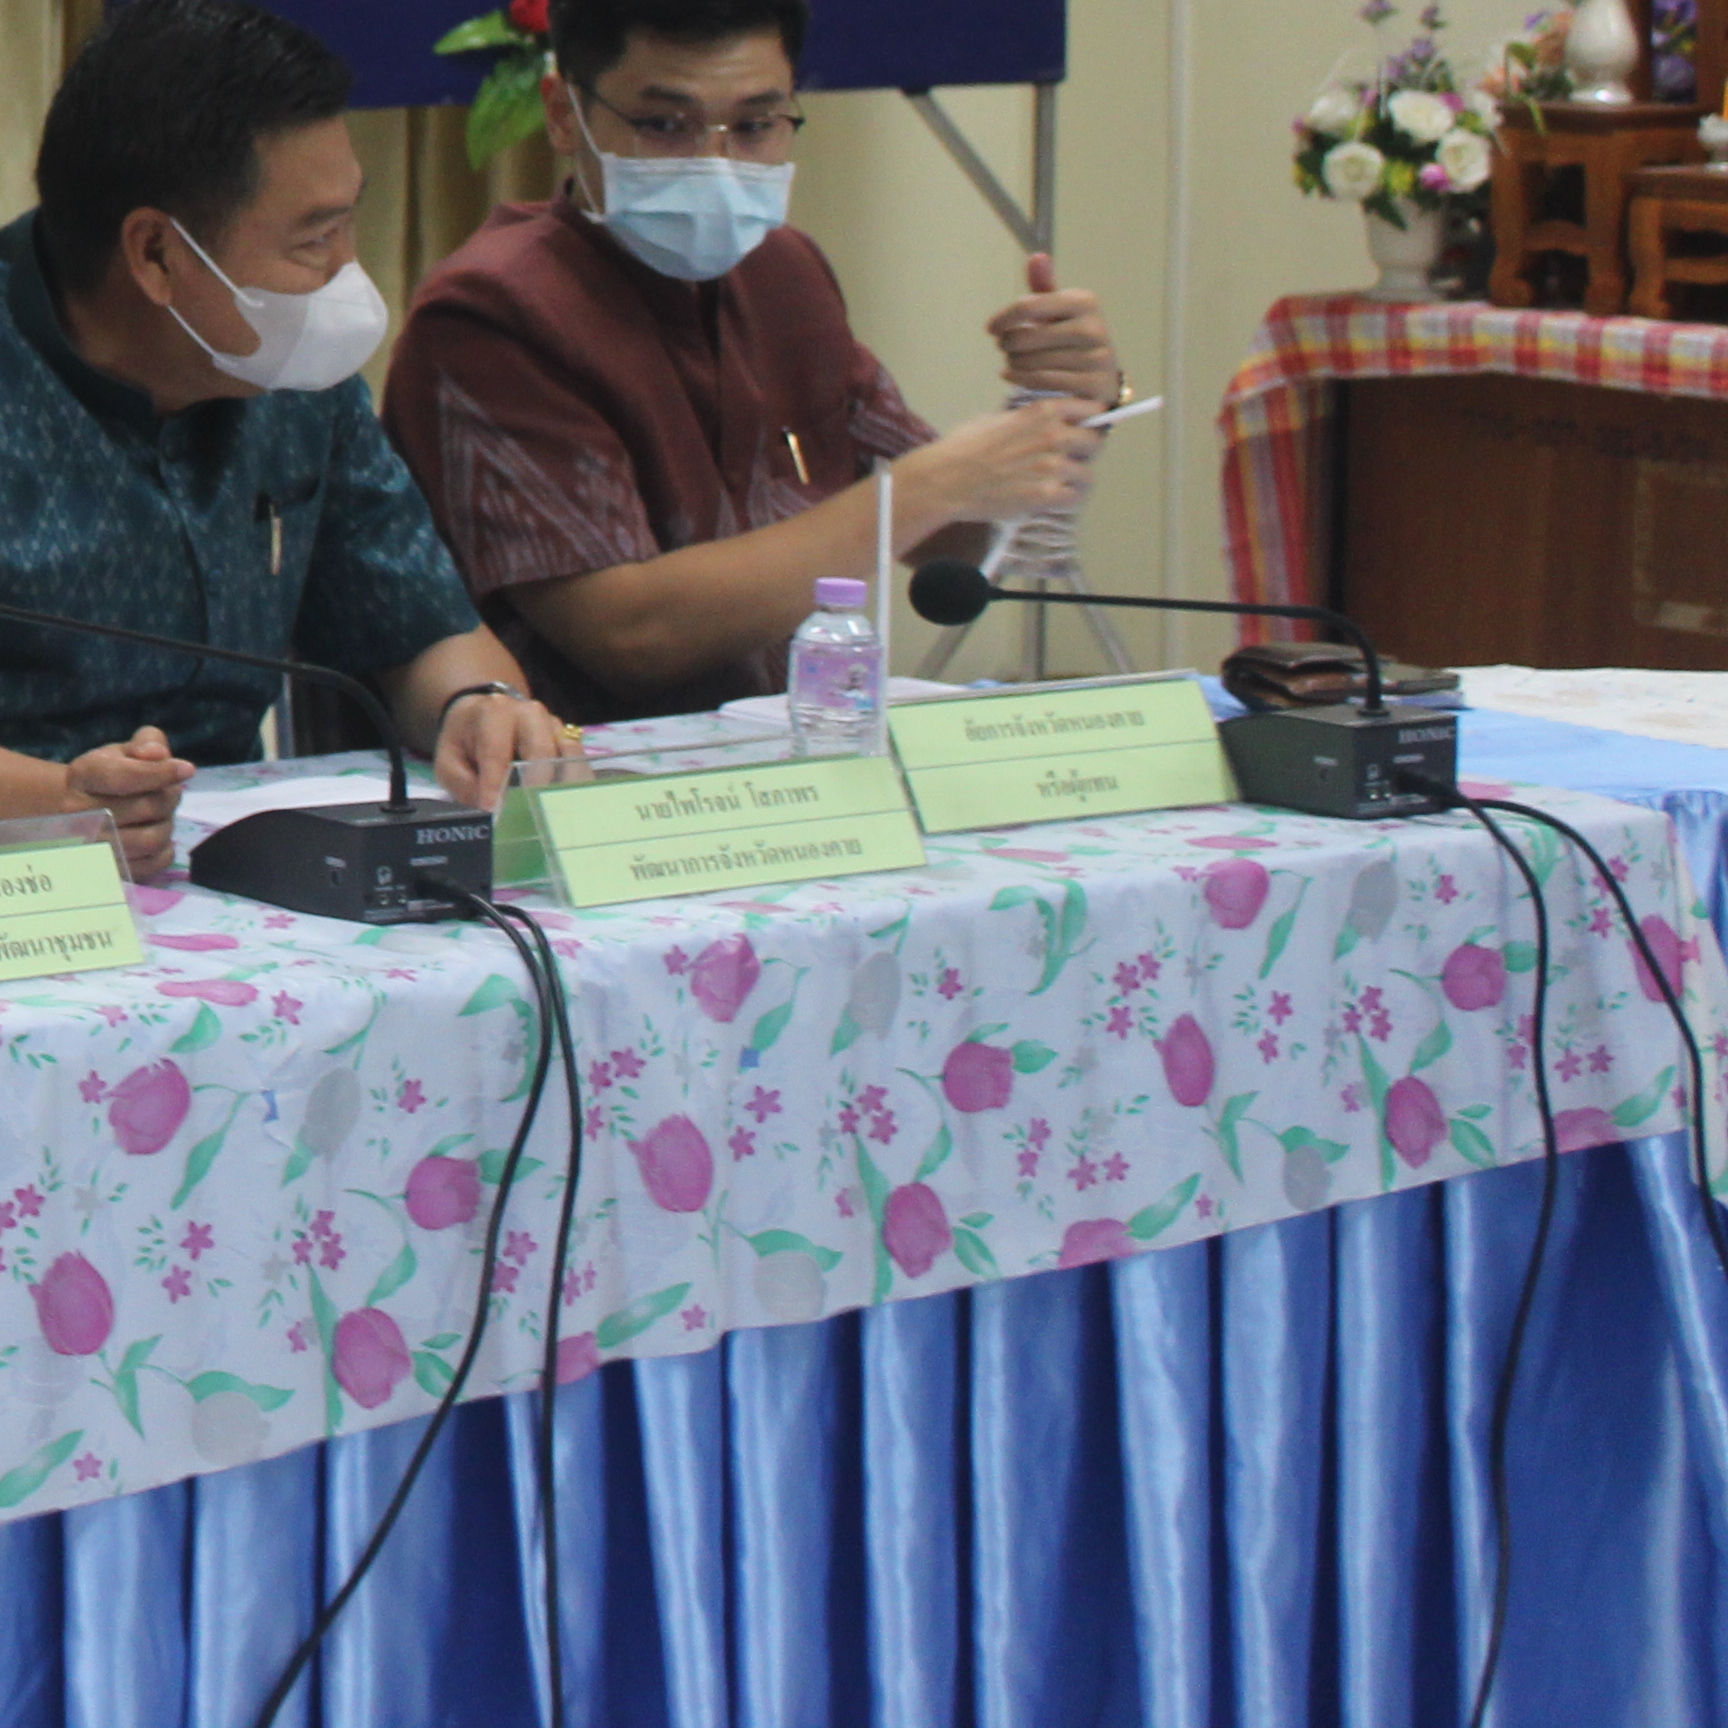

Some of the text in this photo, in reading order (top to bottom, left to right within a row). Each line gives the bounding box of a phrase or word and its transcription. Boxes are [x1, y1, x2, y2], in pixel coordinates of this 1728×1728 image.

[415, 825, 489, 845] HONIC
[630, 837, 863, 881] พัฒนาการจังหวัดหนองคาย
